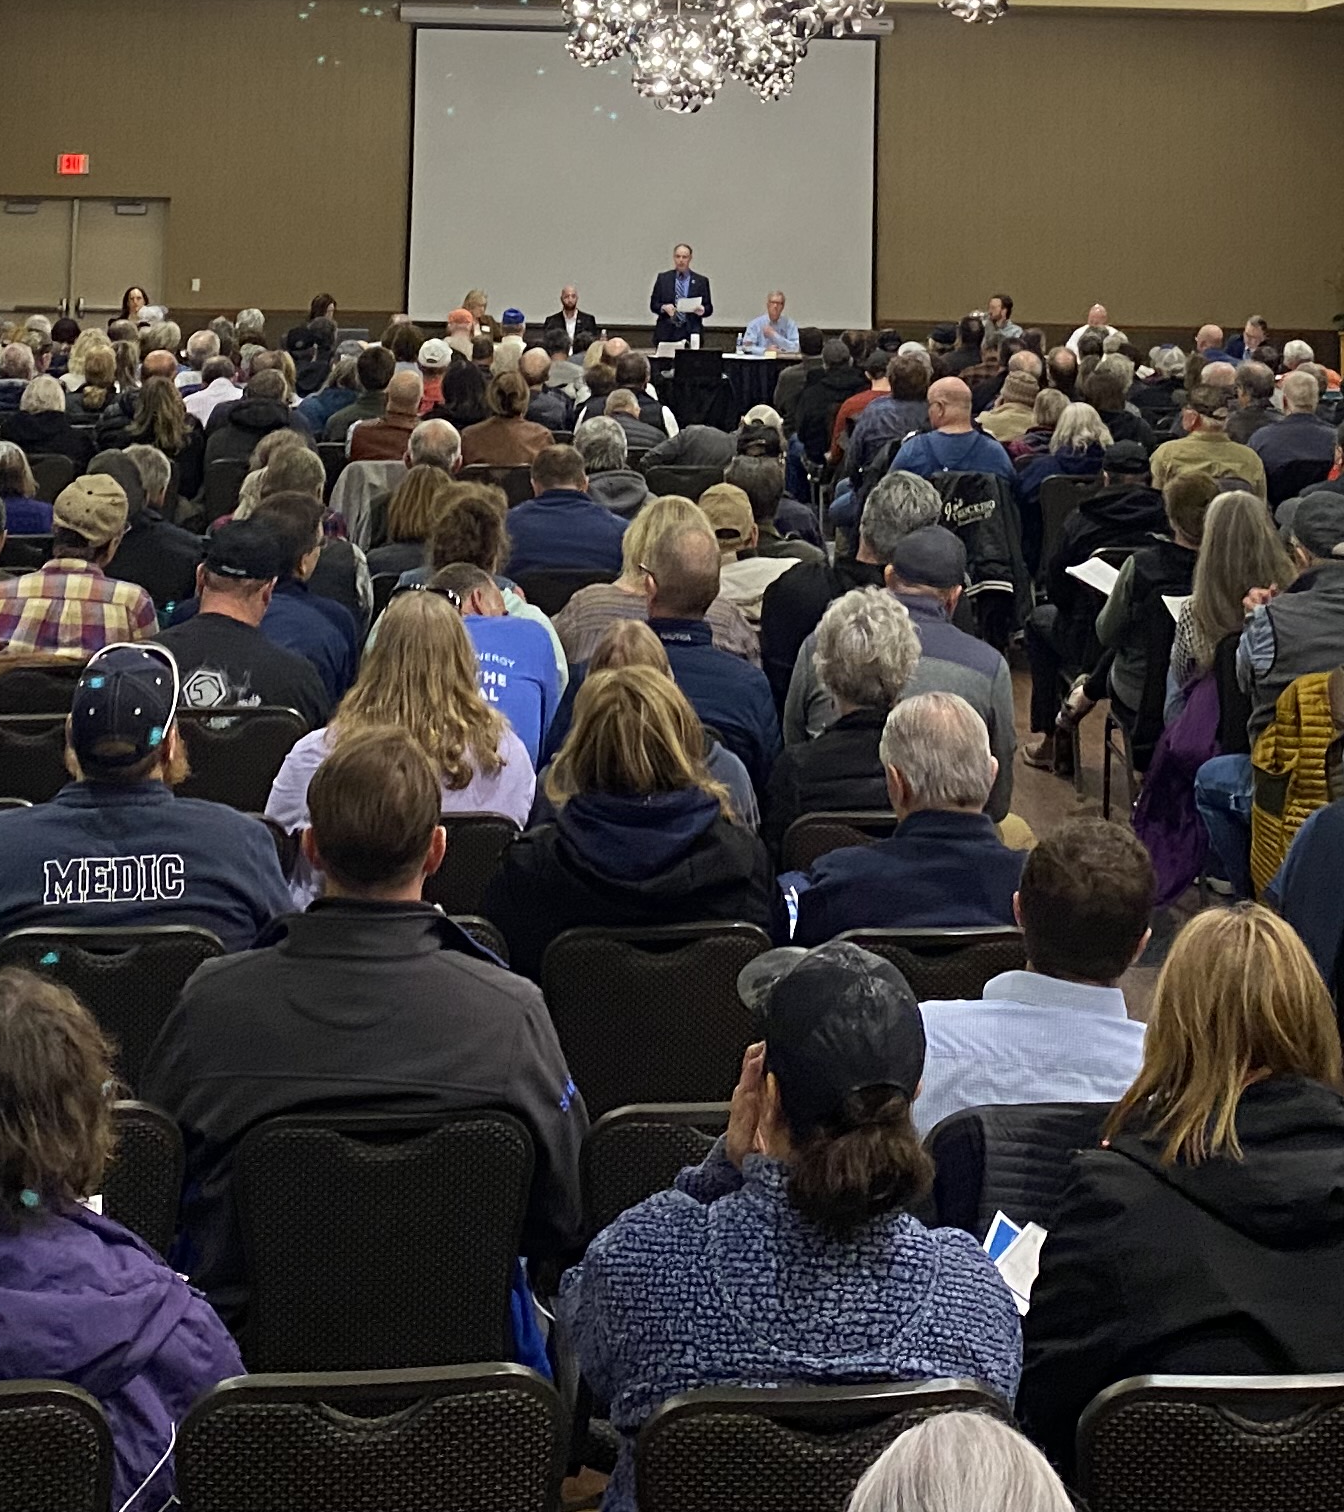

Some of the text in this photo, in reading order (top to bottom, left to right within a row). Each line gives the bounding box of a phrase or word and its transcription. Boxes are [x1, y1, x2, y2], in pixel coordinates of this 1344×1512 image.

[475, 652, 516, 668] NERGY
[477, 687, 499, 701] AL
[43, 853, 185, 905] MEDIC
